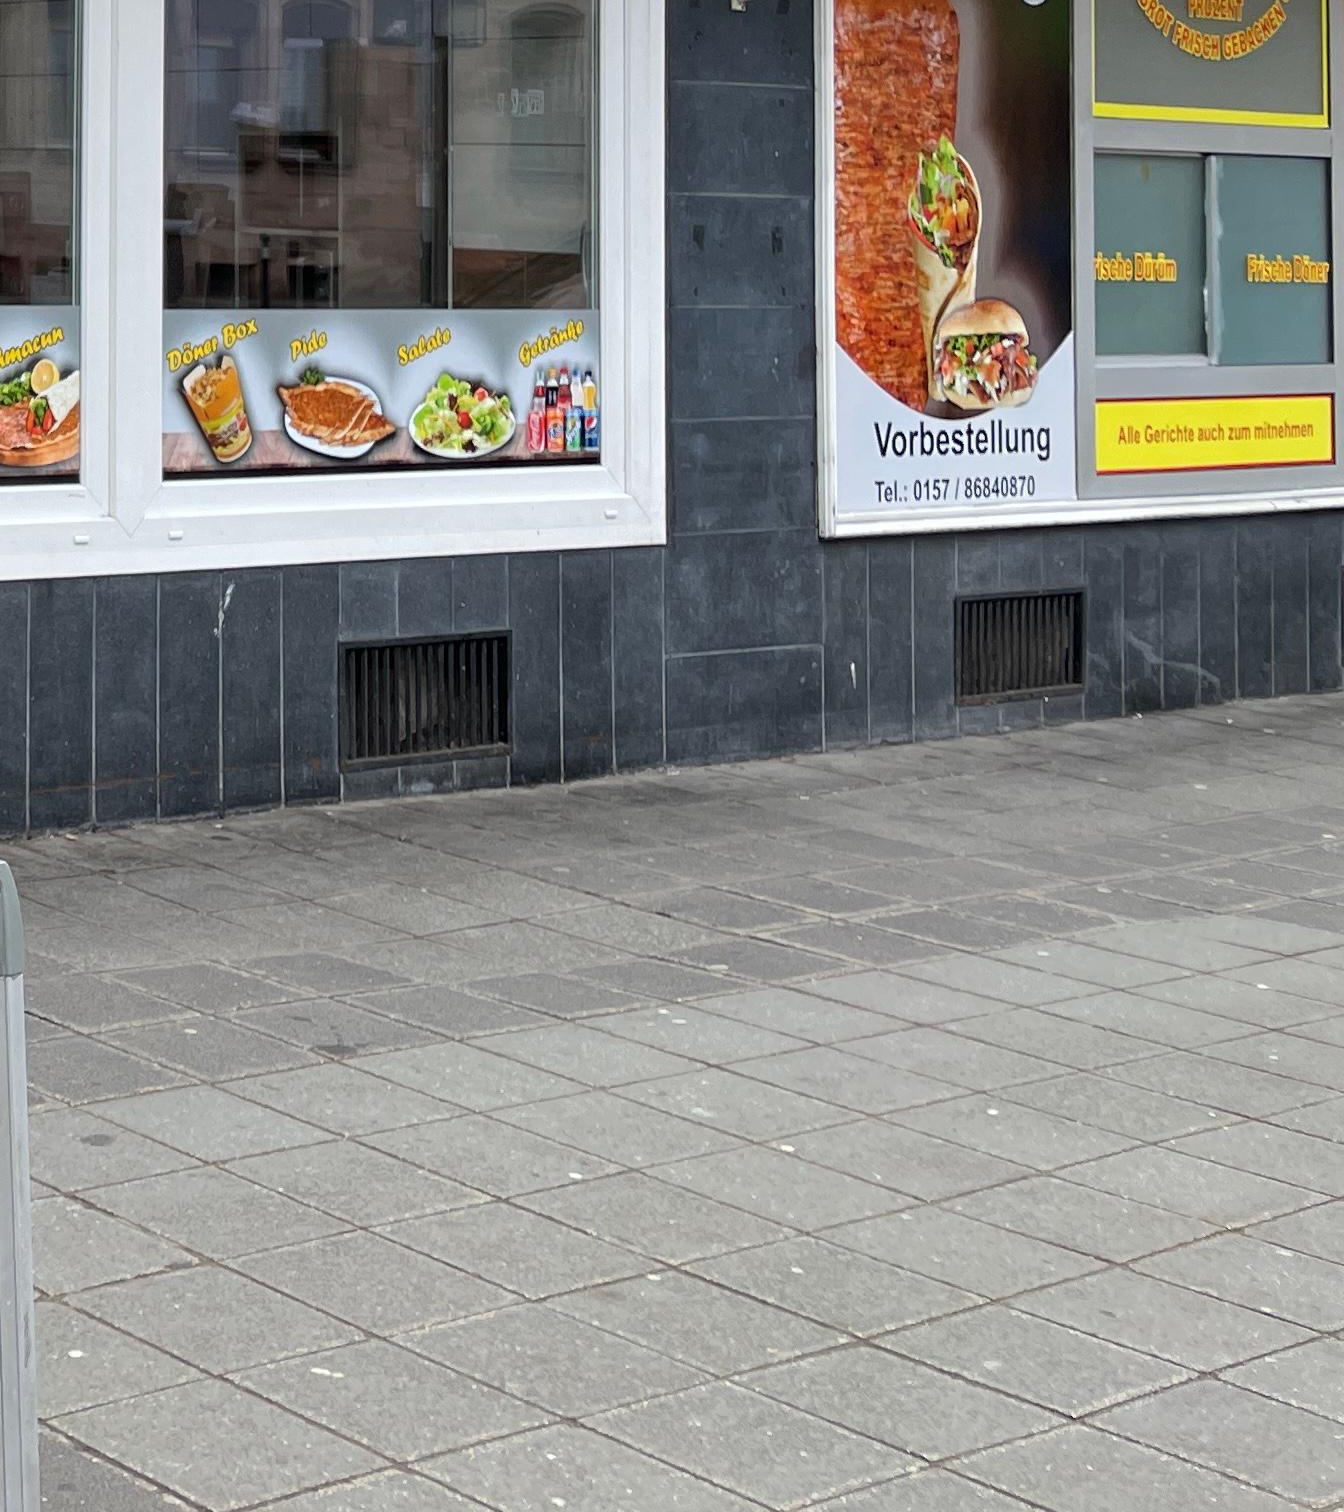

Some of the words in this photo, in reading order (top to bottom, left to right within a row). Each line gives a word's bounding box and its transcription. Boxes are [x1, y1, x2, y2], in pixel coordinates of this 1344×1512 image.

[1172, 20, 1220, 60] FRISCH
[1223, 0, 1287, 60] GEBACKEN
[1134, 252, 1177, 282] Dürüm
[1247, 253, 1291, 283] Frische
[1292, 254, 1329, 284] Döner
[166, 335, 218, 372] Döner
[221, 318, 258, 349] Box
[290, 328, 328, 362] Pide
[397, 326, 452, 366] Salate
[518, 319, 584, 368] Getränke
[874, 420, 1050, 460] Vorbestellung
[1118, 426, 1141, 445] Alle
[1144, 424, 1194, 444] Gerichte
[1198, 424, 1224, 442] auch
[1228, 426, 1251, 441] zum
[1254, 421, 1314, 439] mitnehmen
[875, 481, 908, 503] Tel.:
[913, 478, 950, 501] 0157
[964, 475, 1036, 499] 86840870
